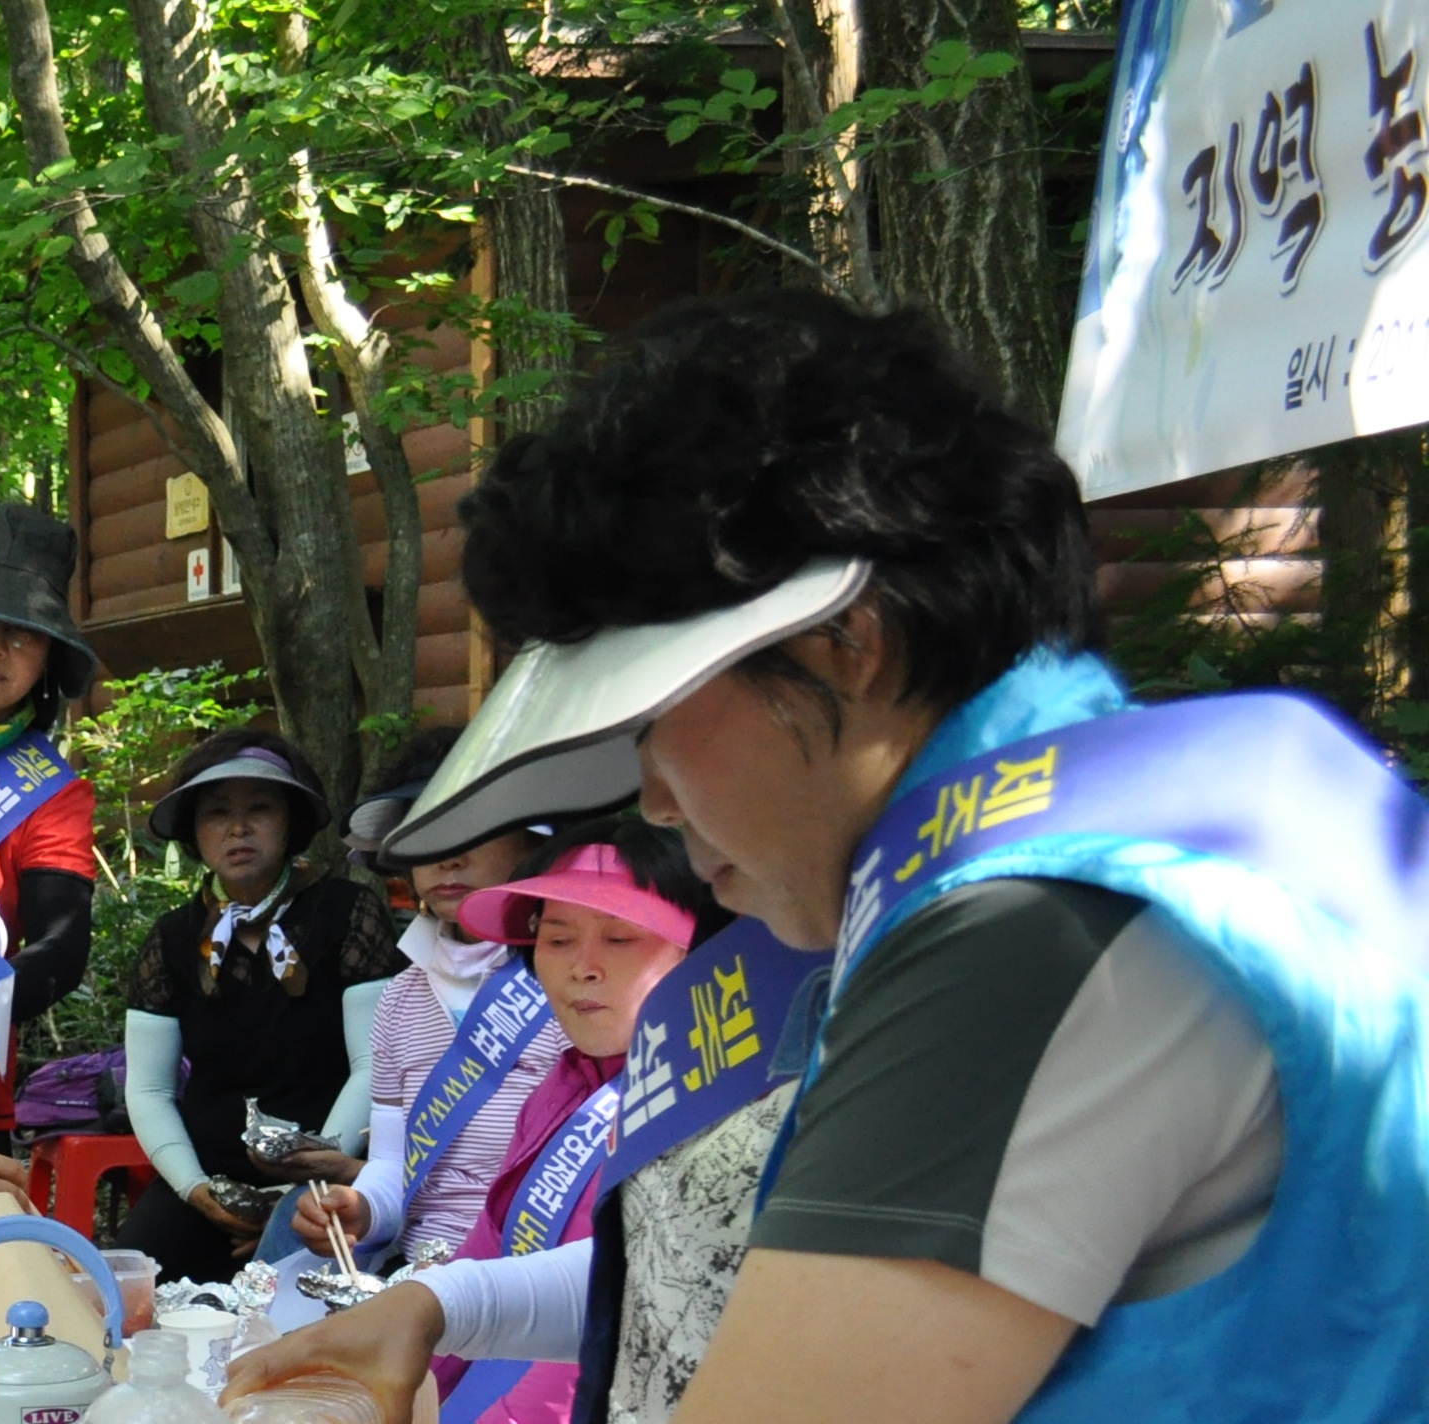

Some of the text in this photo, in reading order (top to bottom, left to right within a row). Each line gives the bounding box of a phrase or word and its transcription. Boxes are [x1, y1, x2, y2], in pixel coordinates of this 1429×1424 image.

[1172, 58, 1324, 297] 지역
[1285, 335, 1336, 411] 일시
[7, 744, 61, 793] 제주,
[892, 743, 1059, 883] 제주,
[682, 954, 761, 1092] 제주,
[30, 1410, 75, 1424] LIVE
